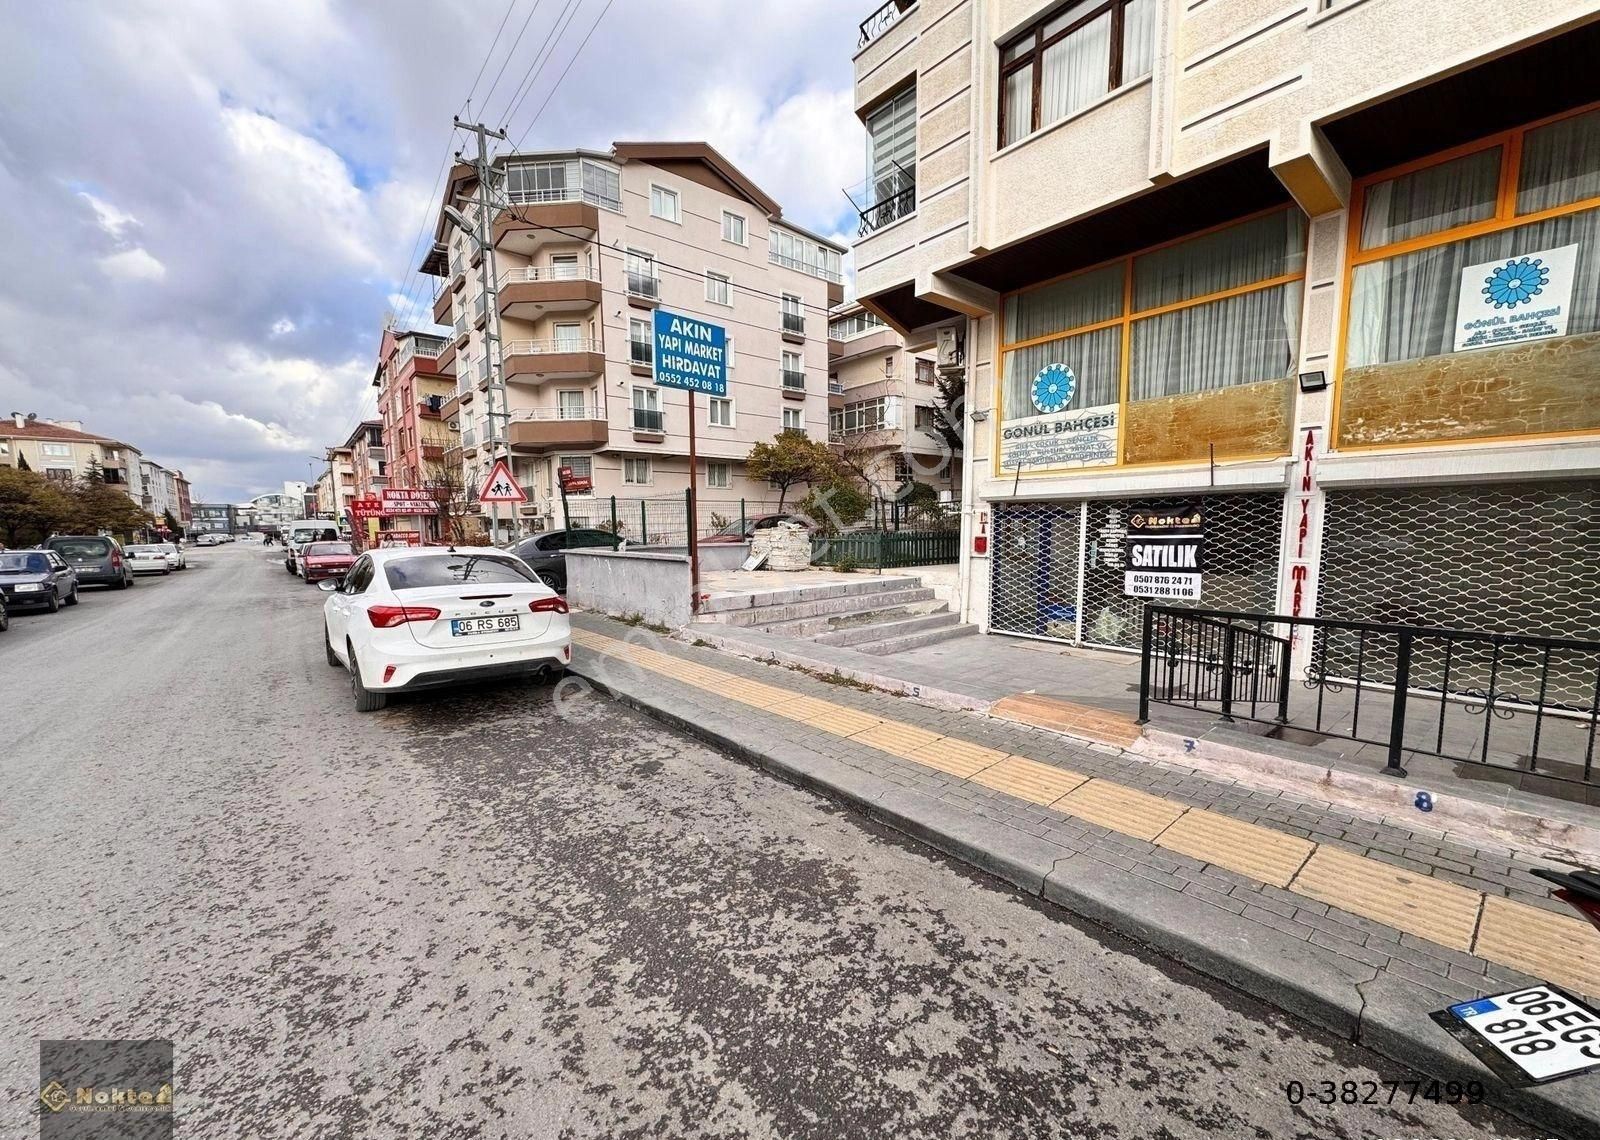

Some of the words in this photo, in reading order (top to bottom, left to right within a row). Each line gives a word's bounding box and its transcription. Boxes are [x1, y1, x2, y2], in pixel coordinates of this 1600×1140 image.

[670, 318, 712, 342] AKIN
[658, 334, 682, 352] YAPI
[684, 340, 723, 361] MARKET
[662, 354, 721, 379] HIRDAVAT
[659, 371, 682, 384] 0552
[683, 376, 700, 388] 452
[702, 380, 713, 390] 08
[715, 383, 724, 392] 18
[1054, 411, 1115, 432] BAHÇESİ
[1302, 430, 1314, 491] AKIN
[386, 490, 409, 500] NOKTA
[1298, 499, 1309, 559] YAPI
[1131, 544, 1198, 568] SATILIK
[1133, 574, 1153, 584] 0507
[1154, 575, 1170, 585] 876
[1171, 576, 1182, 585] 24
[1183, 577, 1193, 585] 71
[1133, 585, 1153, 594] 0531
[1154, 586, 1171, 595] 288
[1172, 587, 1180, 596] 11
[1181, 588, 1194, 597] 06
[458, 621, 473, 632] 06
[477, 619, 493, 630] RS
[498, 617, 517, 628] 685
[912, 686, 921, 698] 5
[1414, 791, 1433, 812] 8
[1484, 1018, 1557, 1055] 818
